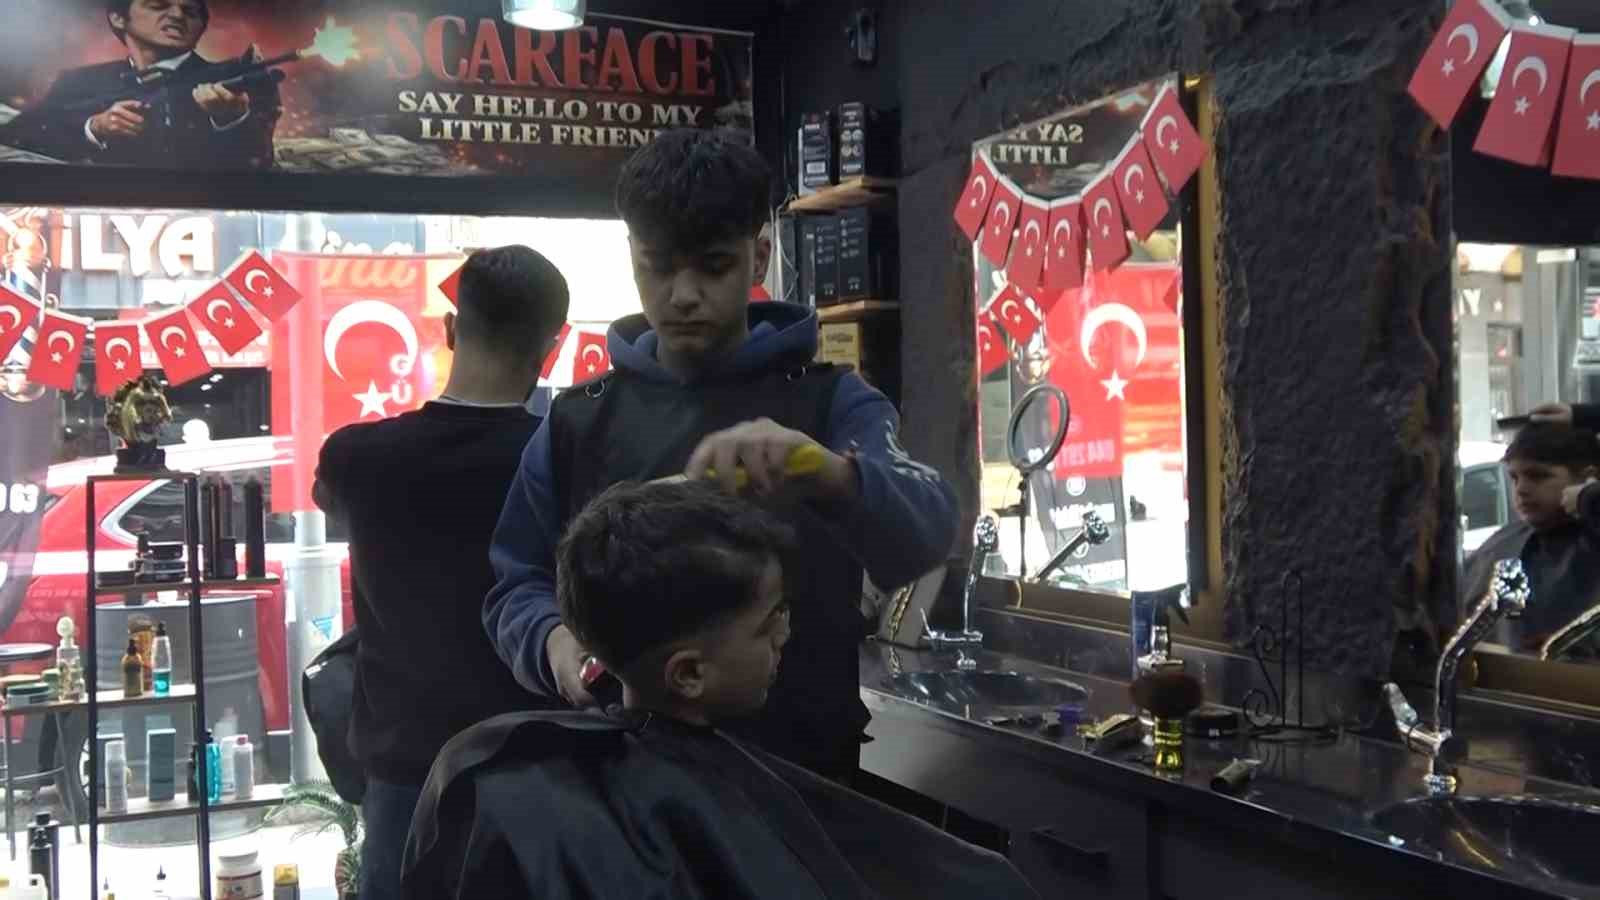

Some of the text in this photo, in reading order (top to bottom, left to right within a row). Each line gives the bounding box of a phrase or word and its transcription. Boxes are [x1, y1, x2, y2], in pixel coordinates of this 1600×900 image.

[385, 10, 715, 97] SCARFACE
[398, 90, 702, 125] SAY HELLO TO MY
[419, 117, 661, 147] LITTLE FRIEN
